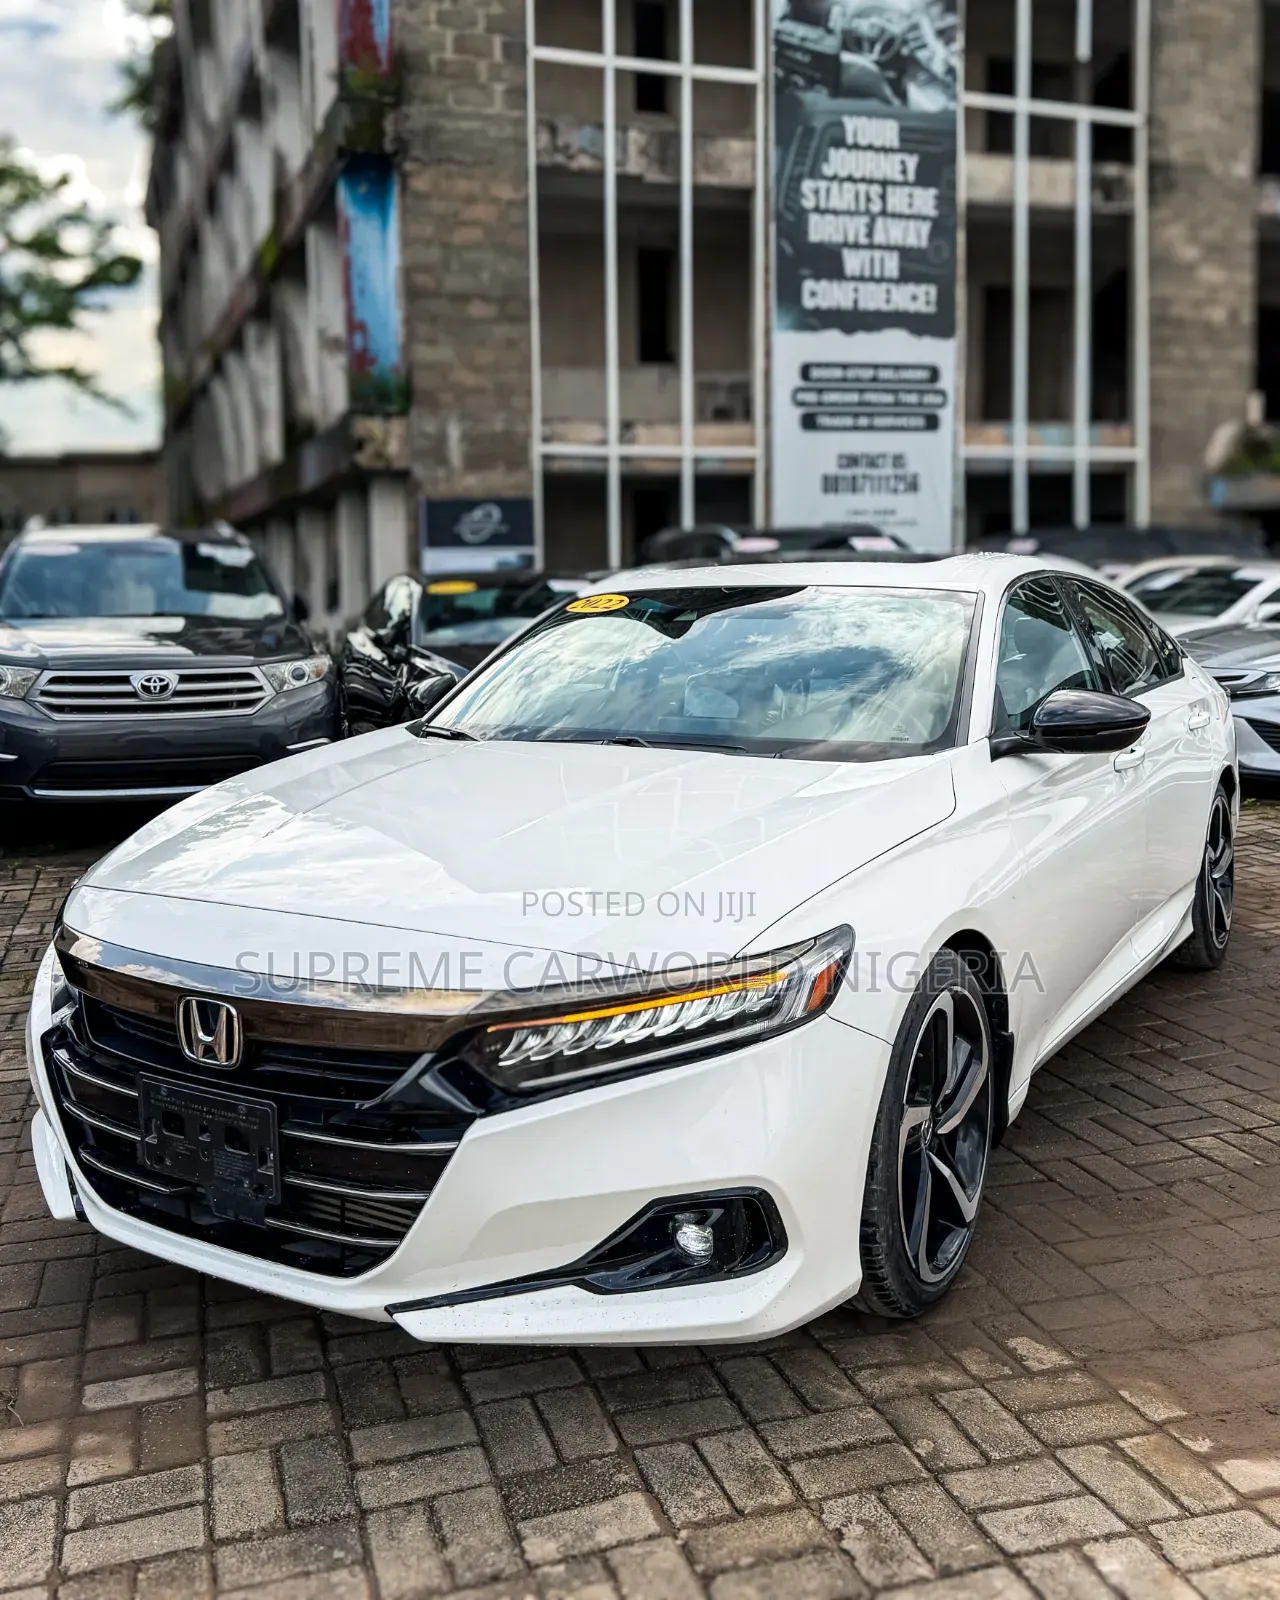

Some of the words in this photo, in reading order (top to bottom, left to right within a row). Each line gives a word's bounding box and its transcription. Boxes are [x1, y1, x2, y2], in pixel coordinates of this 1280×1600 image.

[842, 115, 899, 149] YOUR
[821, 147, 919, 183] JOURNEY
[800, 179, 884, 214] STARTS
[885, 185, 939, 218] HERE
[807, 212, 870, 245] DRIVE
[872, 216, 932, 248] AWAY
[842, 247, 899, 280] WITH
[801, 279, 938, 313] CONFIDENCE!
[568, 598, 625, 610] 2022
